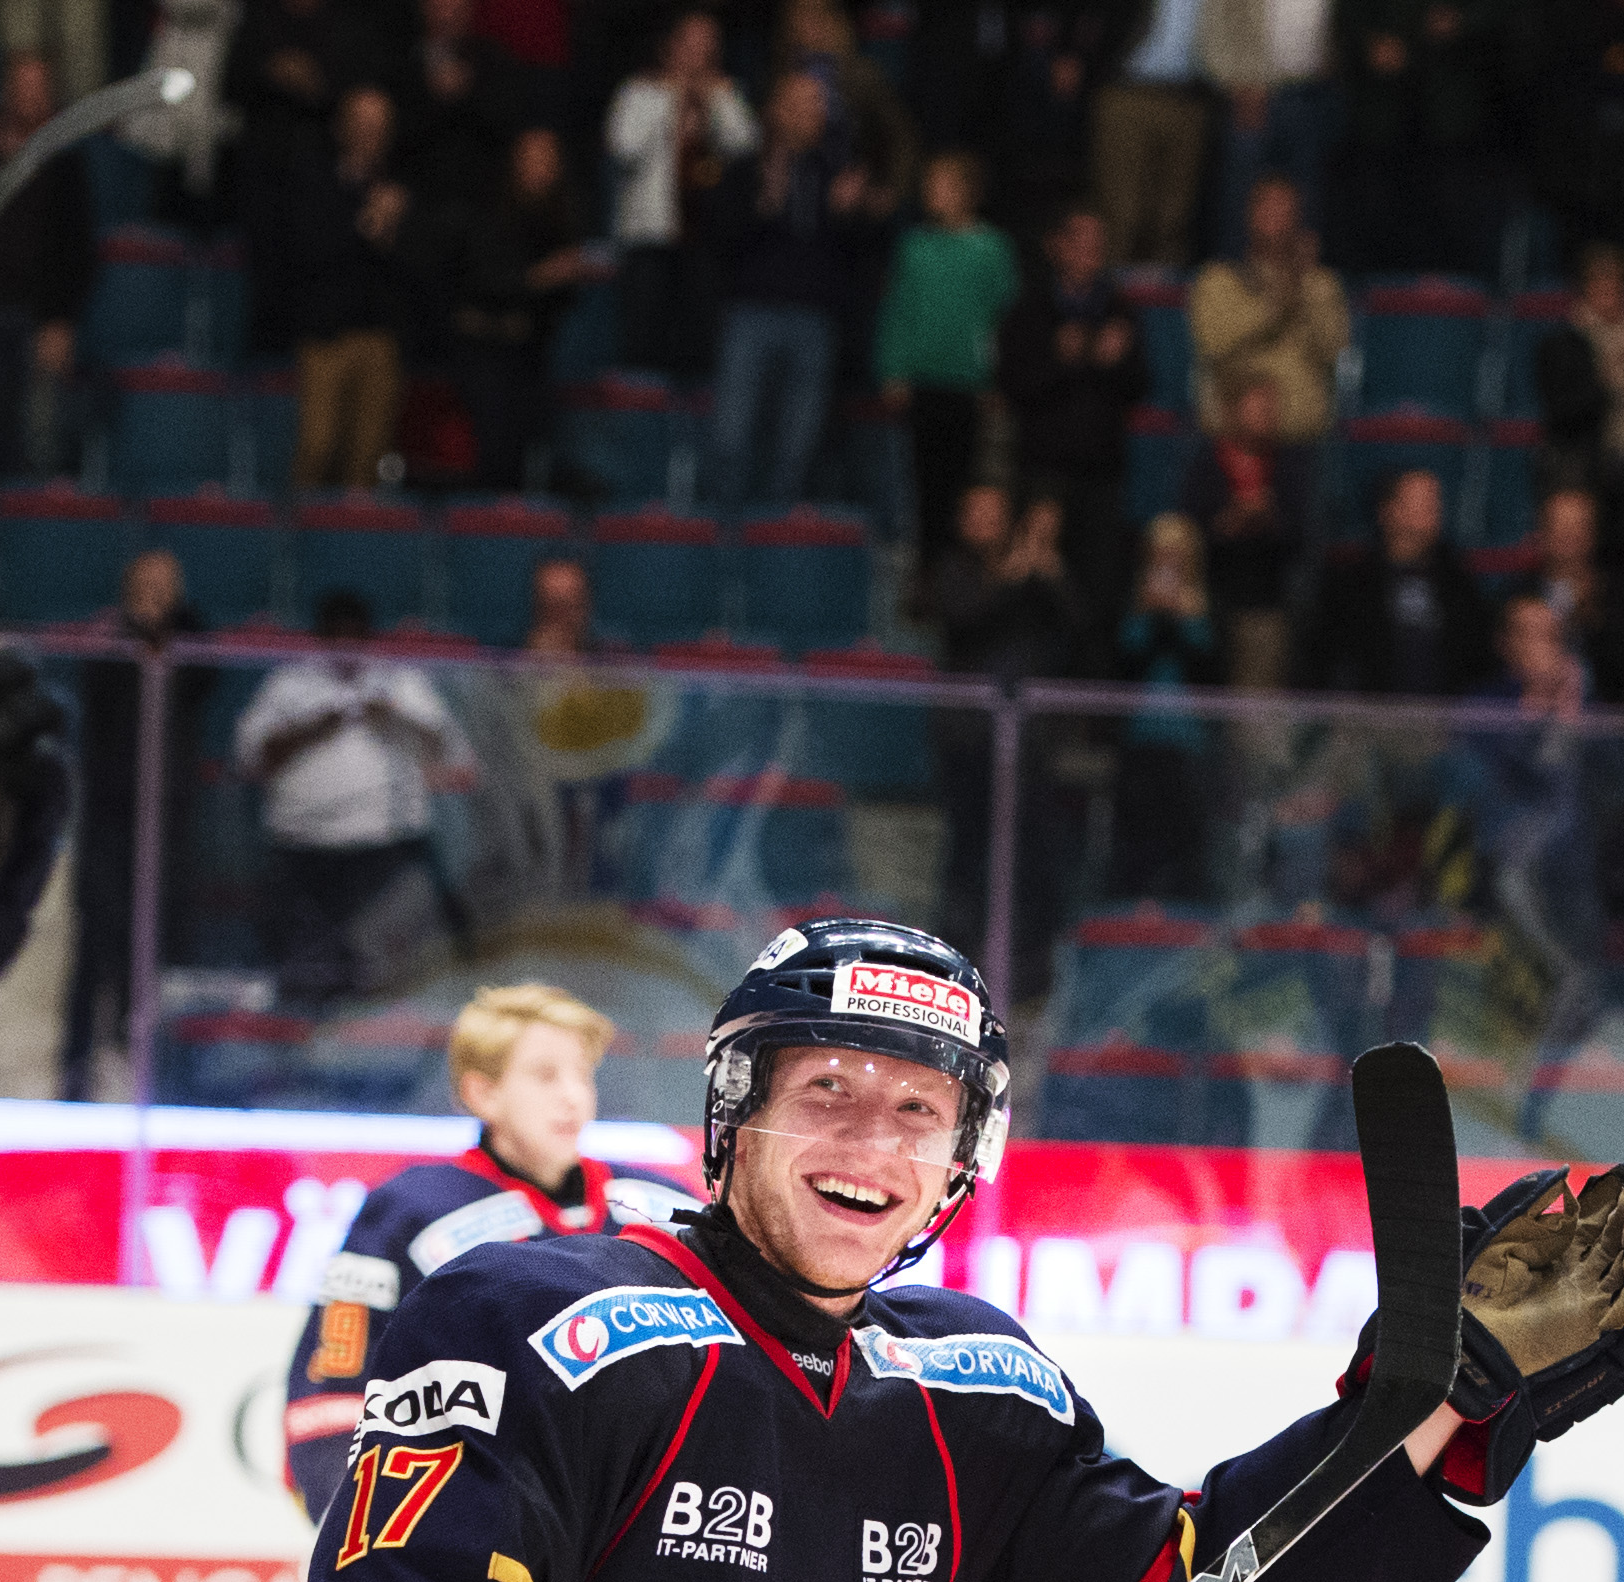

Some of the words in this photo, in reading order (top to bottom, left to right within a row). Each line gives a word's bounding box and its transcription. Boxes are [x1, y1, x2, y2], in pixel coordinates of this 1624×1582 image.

[847, 997, 969, 1038] PROFESSIONAL
[853, 969, 969, 1019] Miele
[786, 1349, 834, 1376] eebo
[929, 1349, 1059, 1400] CORVARA
[335, 1441, 465, 1571] 17
[661, 1482, 774, 1549] B2B
[656, 1538, 768, 1573] IT-PARTNER
[862, 1519, 942, 1576] B2B
